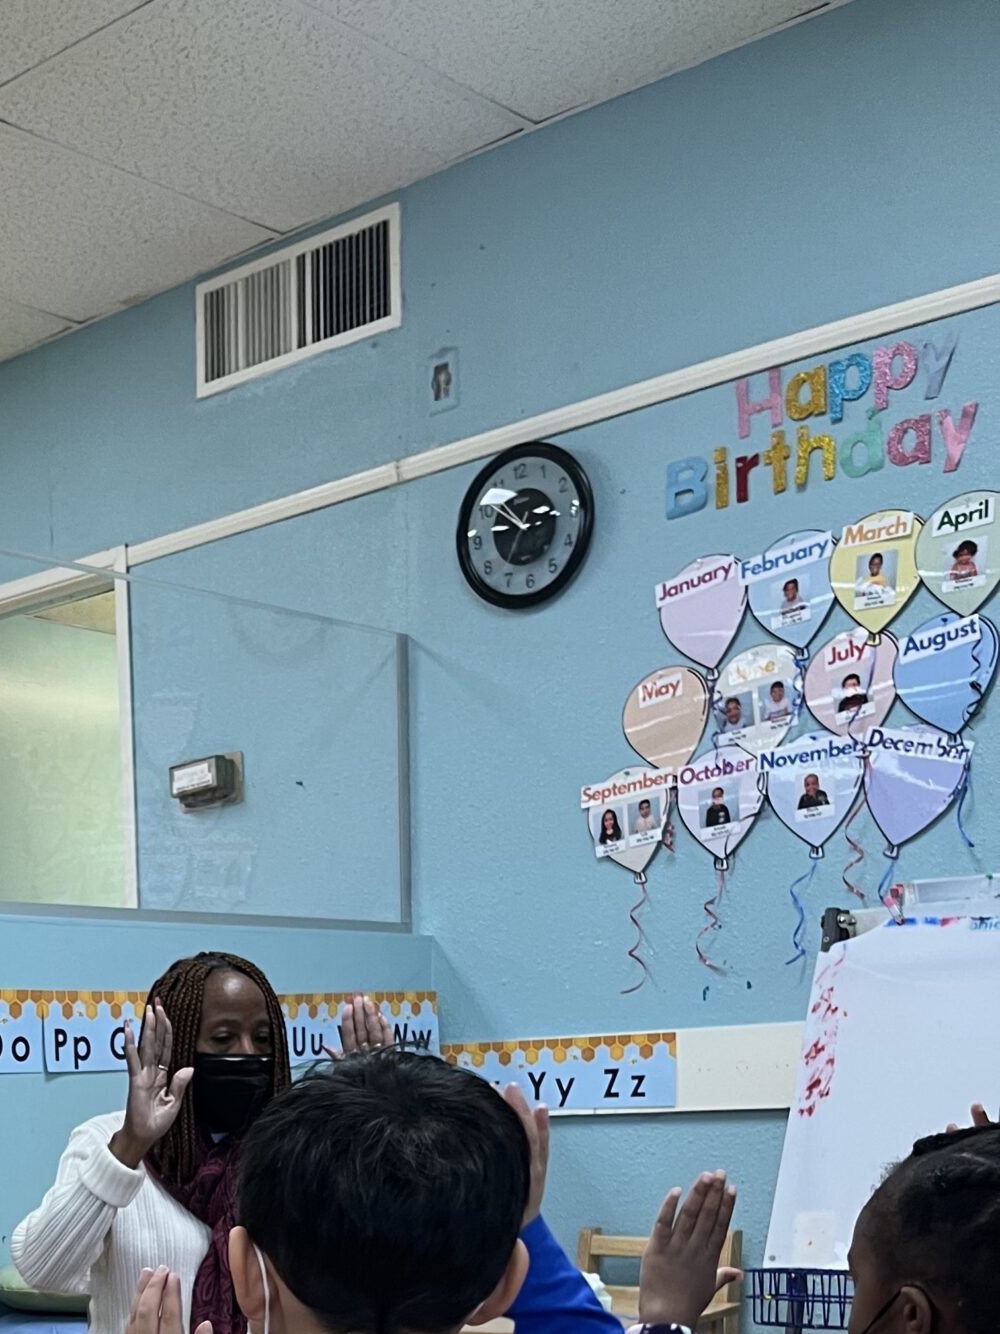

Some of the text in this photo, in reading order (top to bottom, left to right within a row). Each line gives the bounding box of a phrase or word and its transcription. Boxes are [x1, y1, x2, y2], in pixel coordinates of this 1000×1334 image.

[735, 332, 959, 439] Happy
[513, 463, 528, 480] 12
[665, 402, 979, 520] Birthday
[844, 515, 908, 546] March
[937, 499, 989, 532] April
[740, 539, 829, 580] February
[658, 562, 733, 602] January
[827, 639, 867, 666] July
[903, 618, 979, 657] August
[641, 679, 681, 702] May
[679, 757, 754, 785] October
[582, 772, 673, 804] September
[53, 1028, 91, 1070] Pp
[292, 1026, 323, 1057] Uu
[527, 1068, 647, 1108] Yy Zz
